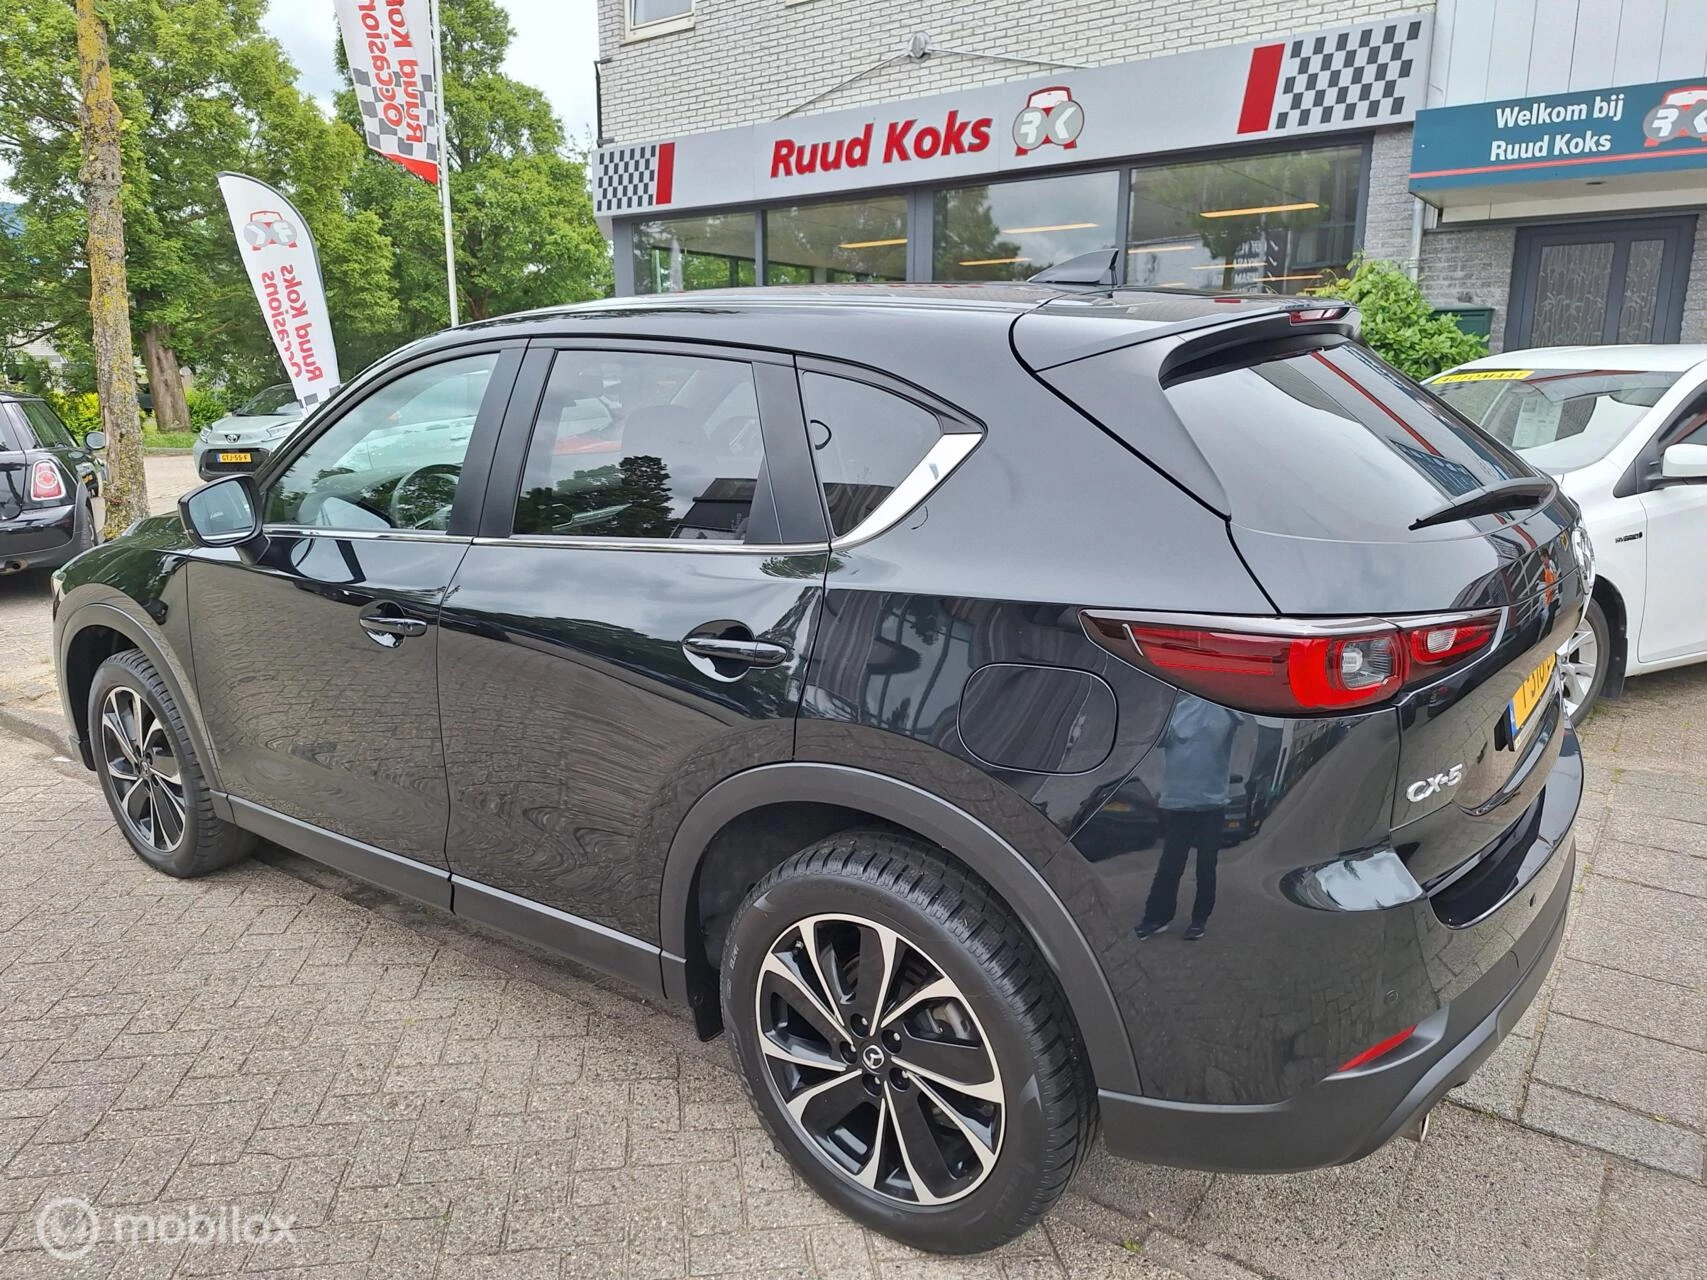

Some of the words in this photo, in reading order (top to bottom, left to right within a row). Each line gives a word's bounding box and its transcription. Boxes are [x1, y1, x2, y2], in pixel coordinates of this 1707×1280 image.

[1496, 102, 1588, 128] Welkom
[1593, 94, 1625, 121] bij
[770, 122, 874, 178] Ruud
[882, 109, 993, 163] Koks
[1490, 135, 1549, 161] Ruud
[1553, 130, 1612, 155] Koks
[1406, 763, 1463, 803] CX-5
